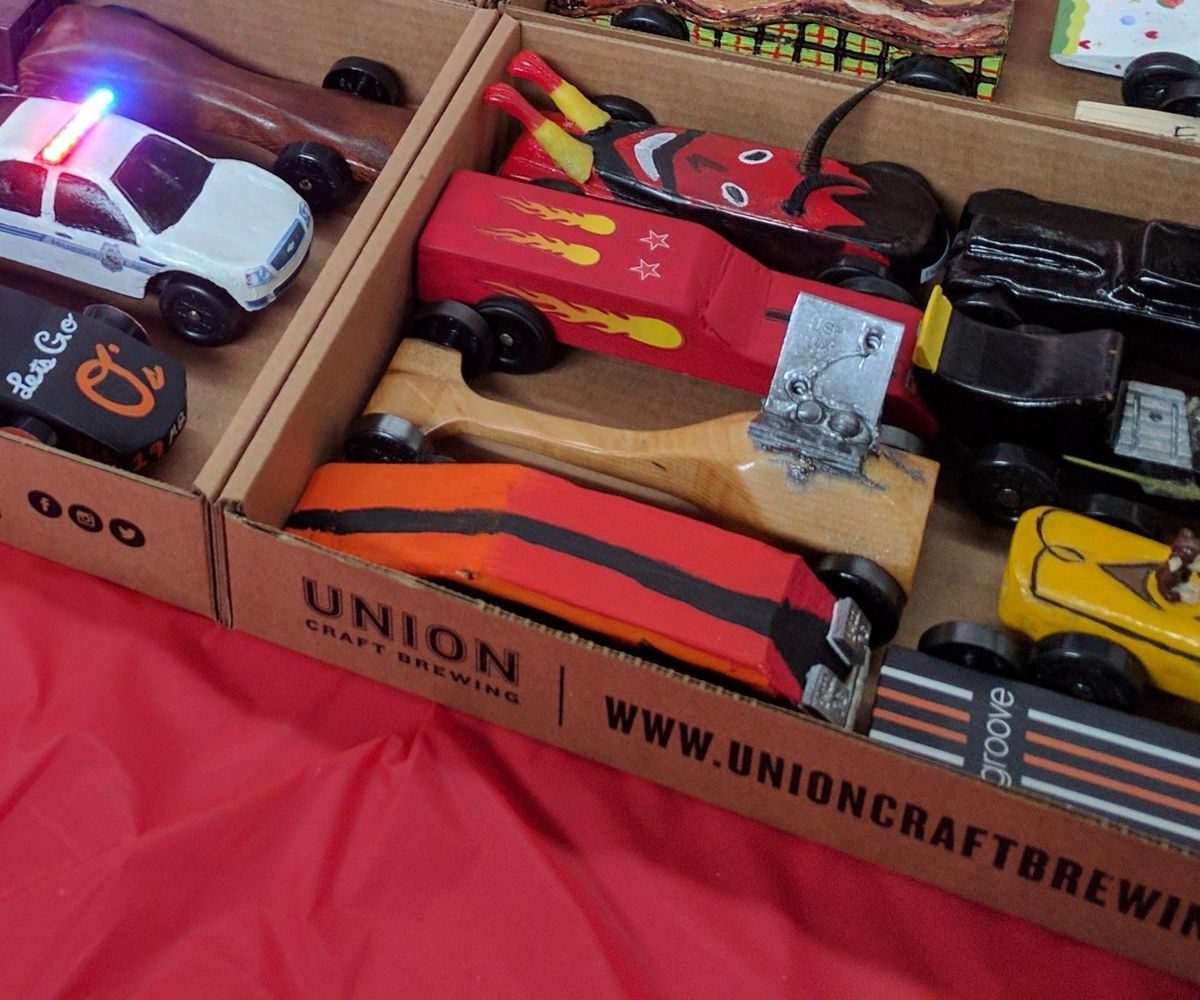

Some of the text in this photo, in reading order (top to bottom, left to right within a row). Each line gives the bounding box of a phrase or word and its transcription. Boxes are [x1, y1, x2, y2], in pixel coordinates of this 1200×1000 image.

[34, 312, 79, 355] Go
[302, 576, 520, 687] UNION
[305, 618, 520, 704] CRAFT BREWING
[981, 686, 1015, 788] groove
